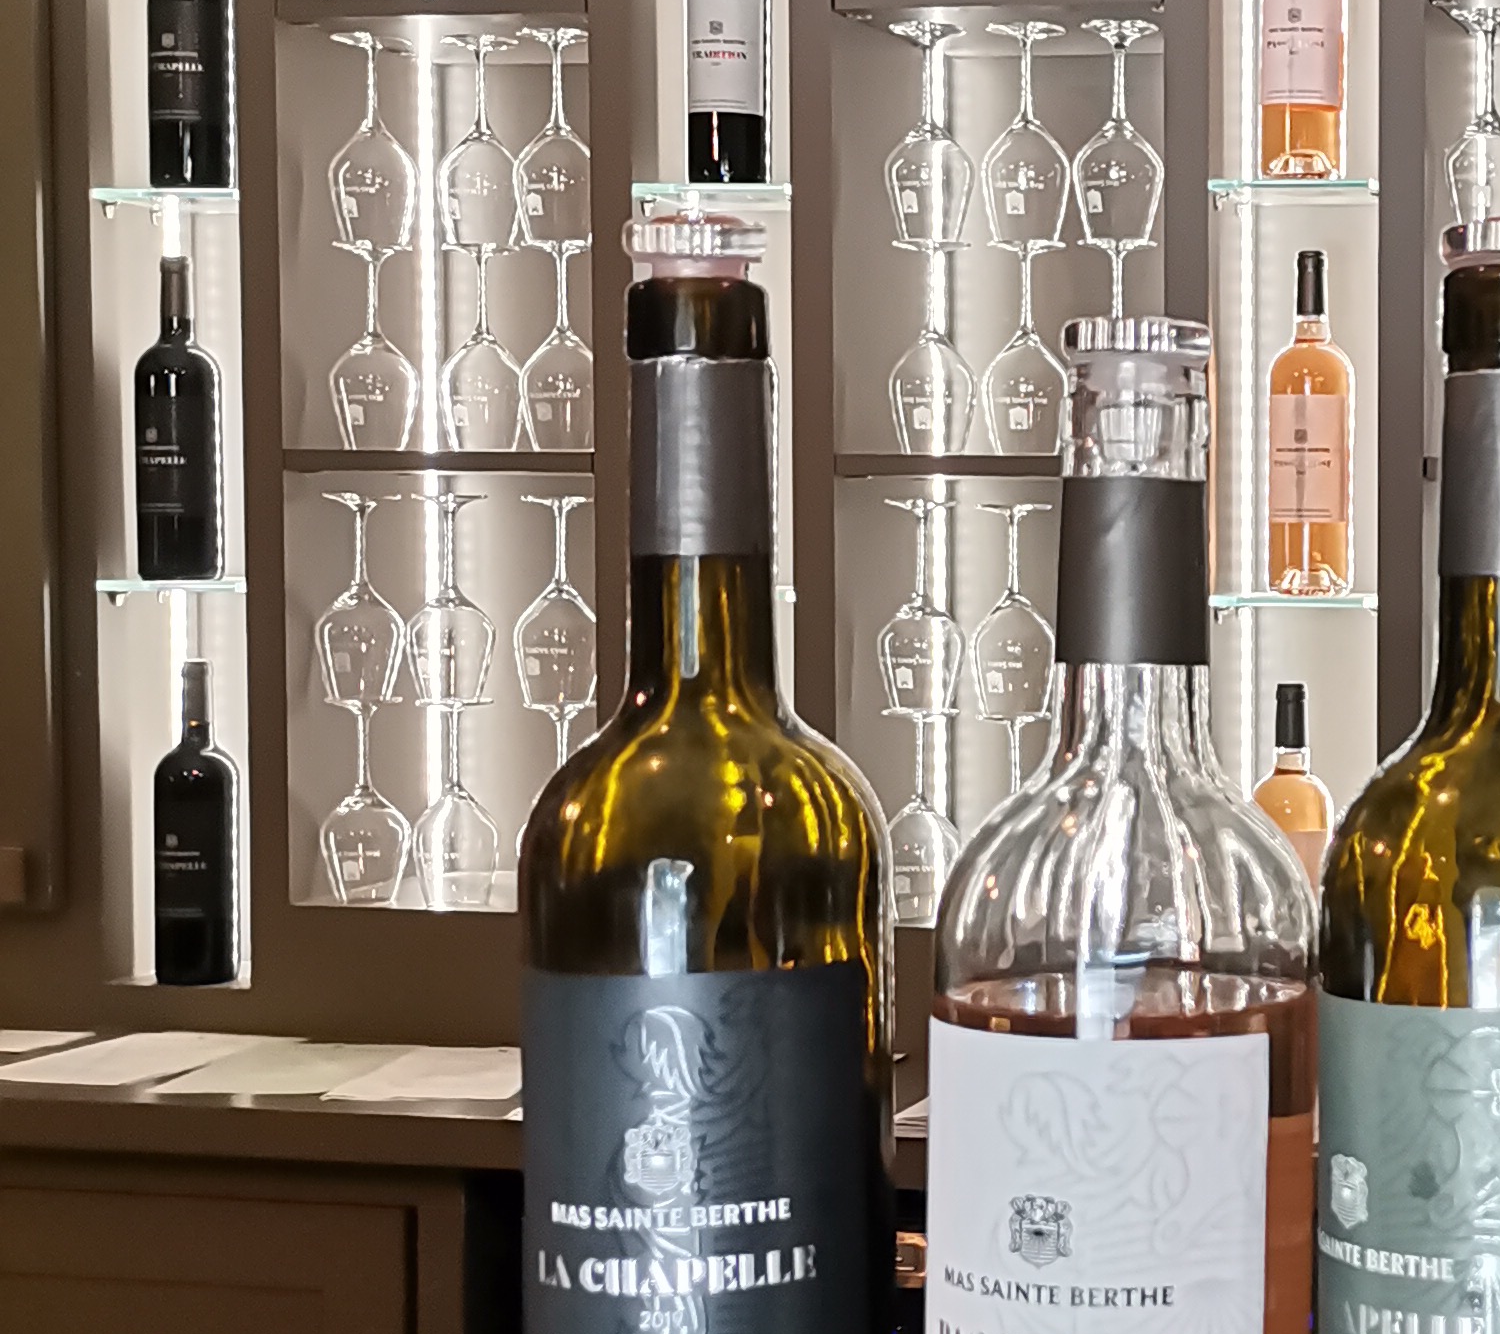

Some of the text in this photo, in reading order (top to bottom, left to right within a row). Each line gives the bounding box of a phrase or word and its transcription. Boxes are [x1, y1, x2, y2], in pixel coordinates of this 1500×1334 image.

[551, 1197, 791, 1230] MAS SAINTE BERTHE
[538, 1244, 817, 1296] LA CHAPELLE
[1364, 1248, 1456, 1283] BERTHE
[944, 1264, 1175, 1308] MAS SAINTE BERTHE
